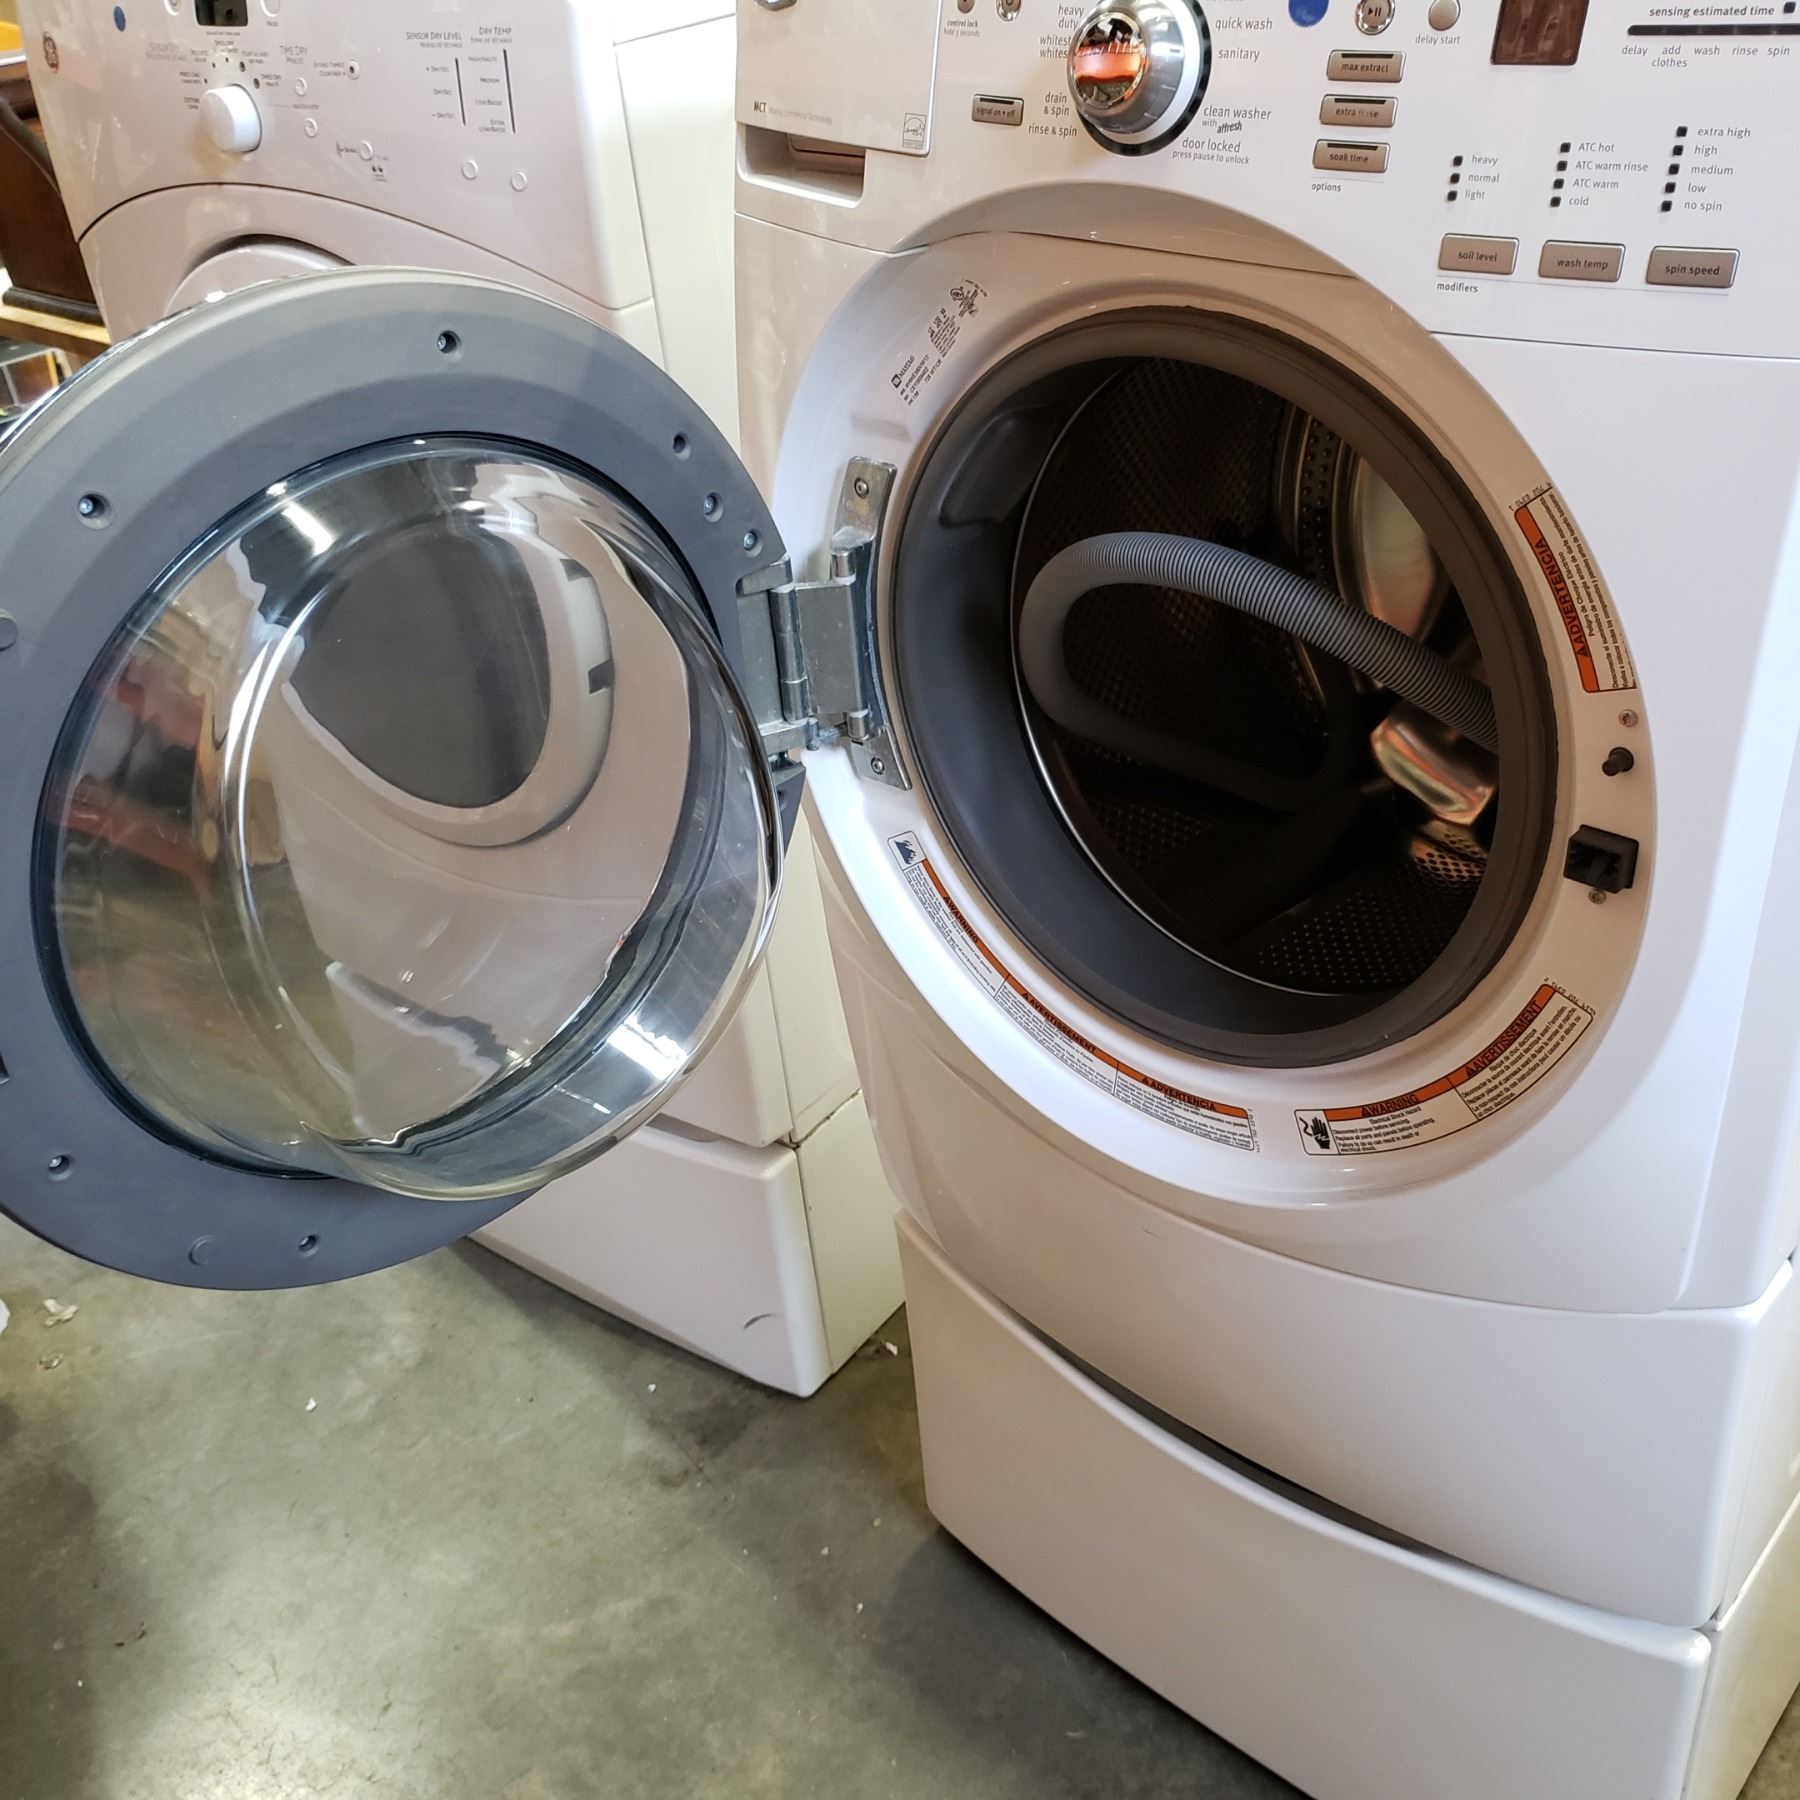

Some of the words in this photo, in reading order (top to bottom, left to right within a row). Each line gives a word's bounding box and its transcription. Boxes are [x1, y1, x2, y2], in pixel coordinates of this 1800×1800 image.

[1058, 3, 1084, 18] heavy
[1650, 6, 1690, 17] sensing
[1693, 6, 1747, 16] estimated
[1750, 6, 1774, 15] time
[947, 20, 966, 28] control
[967, 20, 978, 28] lock
[1058, 17, 1079, 30] duty
[1215, 16, 1243, 32] quick
[1245, 18, 1273, 30] wash
[1039, 35, 1072, 46] whitest
[1415, 34, 1437, 46] delay
[1441, 35, 1460, 45] start
[1039, 48, 1068, 59] whites
[1218, 48, 1260, 63] sanitary
[1621, 45, 1648, 56] delay
[1662, 45, 1681, 55] add
[1694, 45, 1720, 55] wash
[1732, 46, 1758, 55] rinse
[1767, 46, 1790, 56] spin
[1342, 63, 1359, 71] max
[1360, 63, 1389, 73] extract
[1651, 58, 1688, 67] clothes
[1045, 92, 1067, 104] drain
[754, 101, 766, 113] MCT
[1043, 107, 1049, 115] &
[1051, 105, 1069, 118] spin
[1204, 105, 1230, 118] clean
[1234, 107, 1272, 120] washer
[1336, 107, 1356, 116] extra
[1028, 123, 1049, 135] rinse
[1051, 127, 1056, 135] &
[1058, 126, 1077, 139] spin
[1202, 118, 1217, 128] with
[1217, 121, 1243, 134] affresh
[1698, 128, 1724, 137] extra
[1727, 127, 1751, 139] high
[1182, 137, 1205, 150] door
[1207, 139, 1241, 153] locked
[1578, 142, 1595, 152] ATC
[1598, 142, 1615, 153] hot
[1694, 145, 1717, 156] high
[1173, 151, 1192, 160] press
[1193, 152, 1215, 161] pause
[1217, 154, 1224, 162] to
[1226, 154, 1250, 165] unlock
[1330, 153, 1348, 162] soak
[1350, 154, 1369, 163] time
[1472, 154, 1498, 166] heavy
[1575, 160, 1593, 171] ATC
[1594, 163, 1621, 172] warm
[1624, 161, 1648, 172] rinse
[1691, 164, 1733, 175] medium
[1468, 173, 1499, 183] normal
[1572, 178, 1590, 189] ATC
[1591, 180, 1619, 189] warm
[1312, 182, 1342, 192] options
[1688, 183, 1706, 193] low
[1465, 190, 1485, 201] light
[1569, 197, 1589, 206] cold
[1684, 201, 1697, 210] no
[1700, 200, 1722, 212] spin
[1458, 250, 1474, 260] soil
[1476, 252, 1498, 262] level
[1557, 258, 1582, 268] wash
[1584, 260, 1608, 272] temp
[1665, 264, 1686, 274] spin
[1689, 265, 1720, 276] speed
[1437, 281, 1478, 293] modifiers
[1532, 536, 1586, 647] ADVERTENCIA
[1570, 579, 1583, 605] Choque
[1580, 604, 1587, 613] de
[1583, 613, 1595, 637] Peligro
[946, 899, 980, 944] WARNING
[1027, 997, 1096, 1054] AVERTISSEMENT
[1471, 1000, 1542, 1071] AVERTISSEMENT
[1149, 1079, 1217, 1111] ADVERTENCIA
[1366, 1093, 1419, 1116] WARNING
